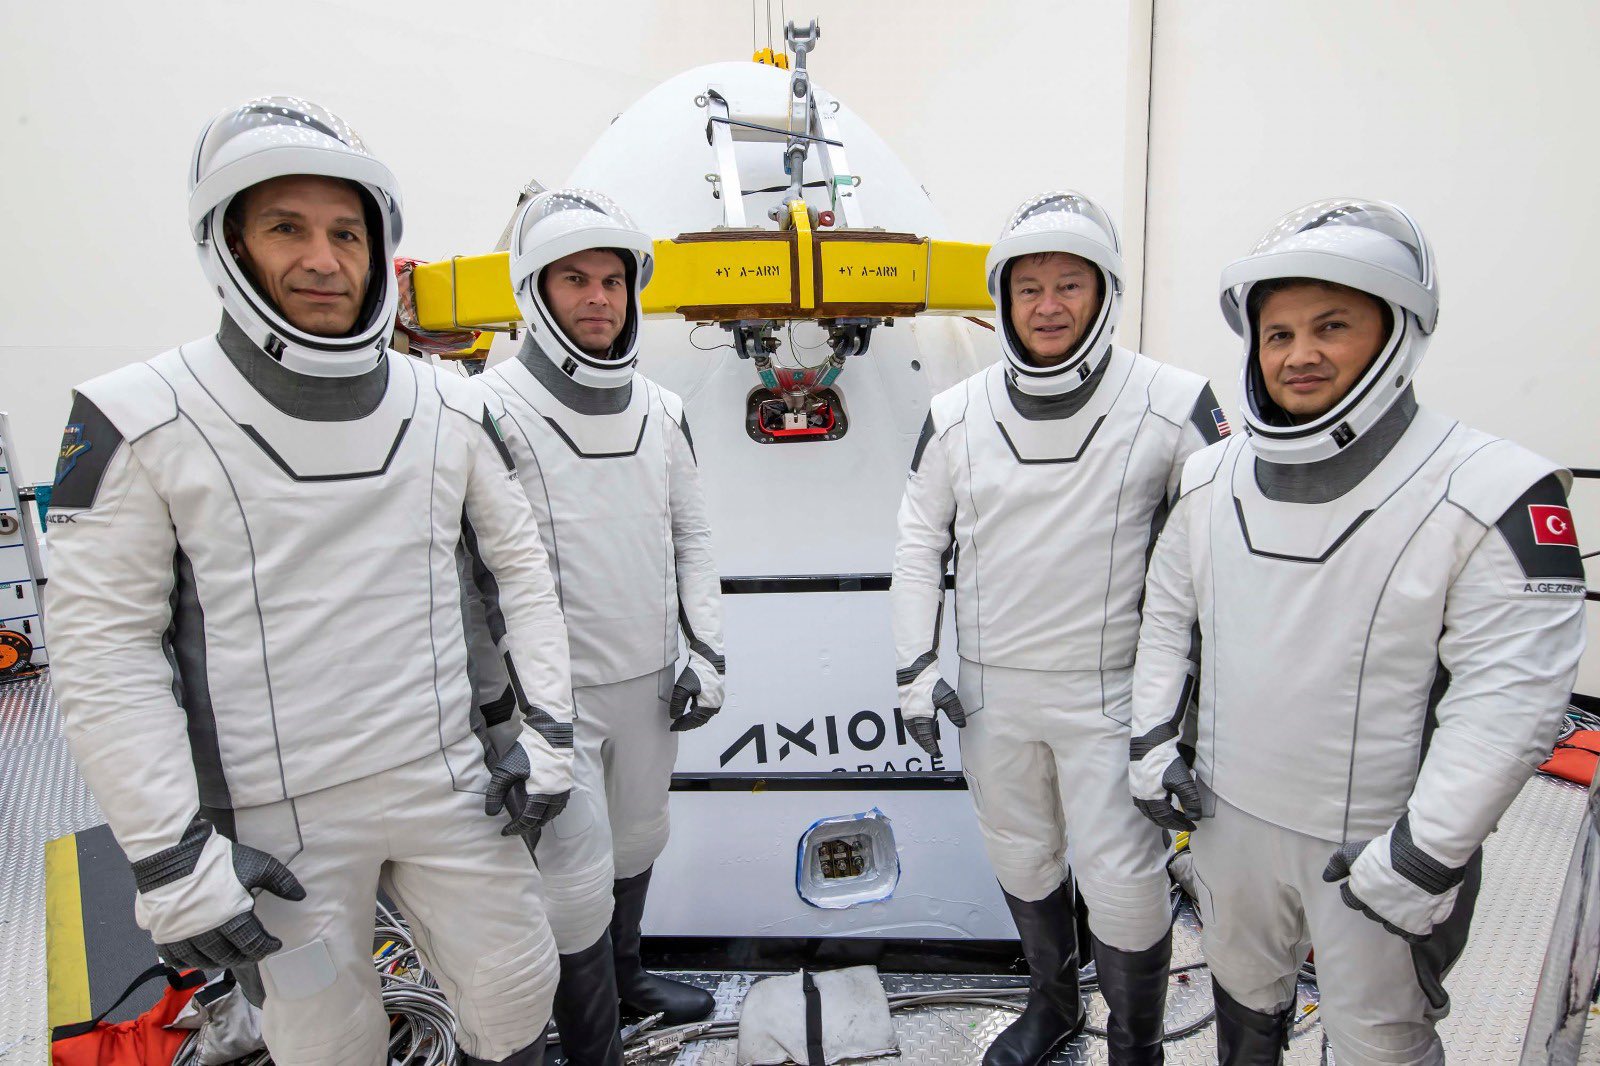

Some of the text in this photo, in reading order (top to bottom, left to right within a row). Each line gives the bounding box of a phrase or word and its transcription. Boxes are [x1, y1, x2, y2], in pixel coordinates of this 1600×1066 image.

[715, 265, 780, 278] +Y A-ARM
[838, 265, 898, 277] +Y A-ARM
